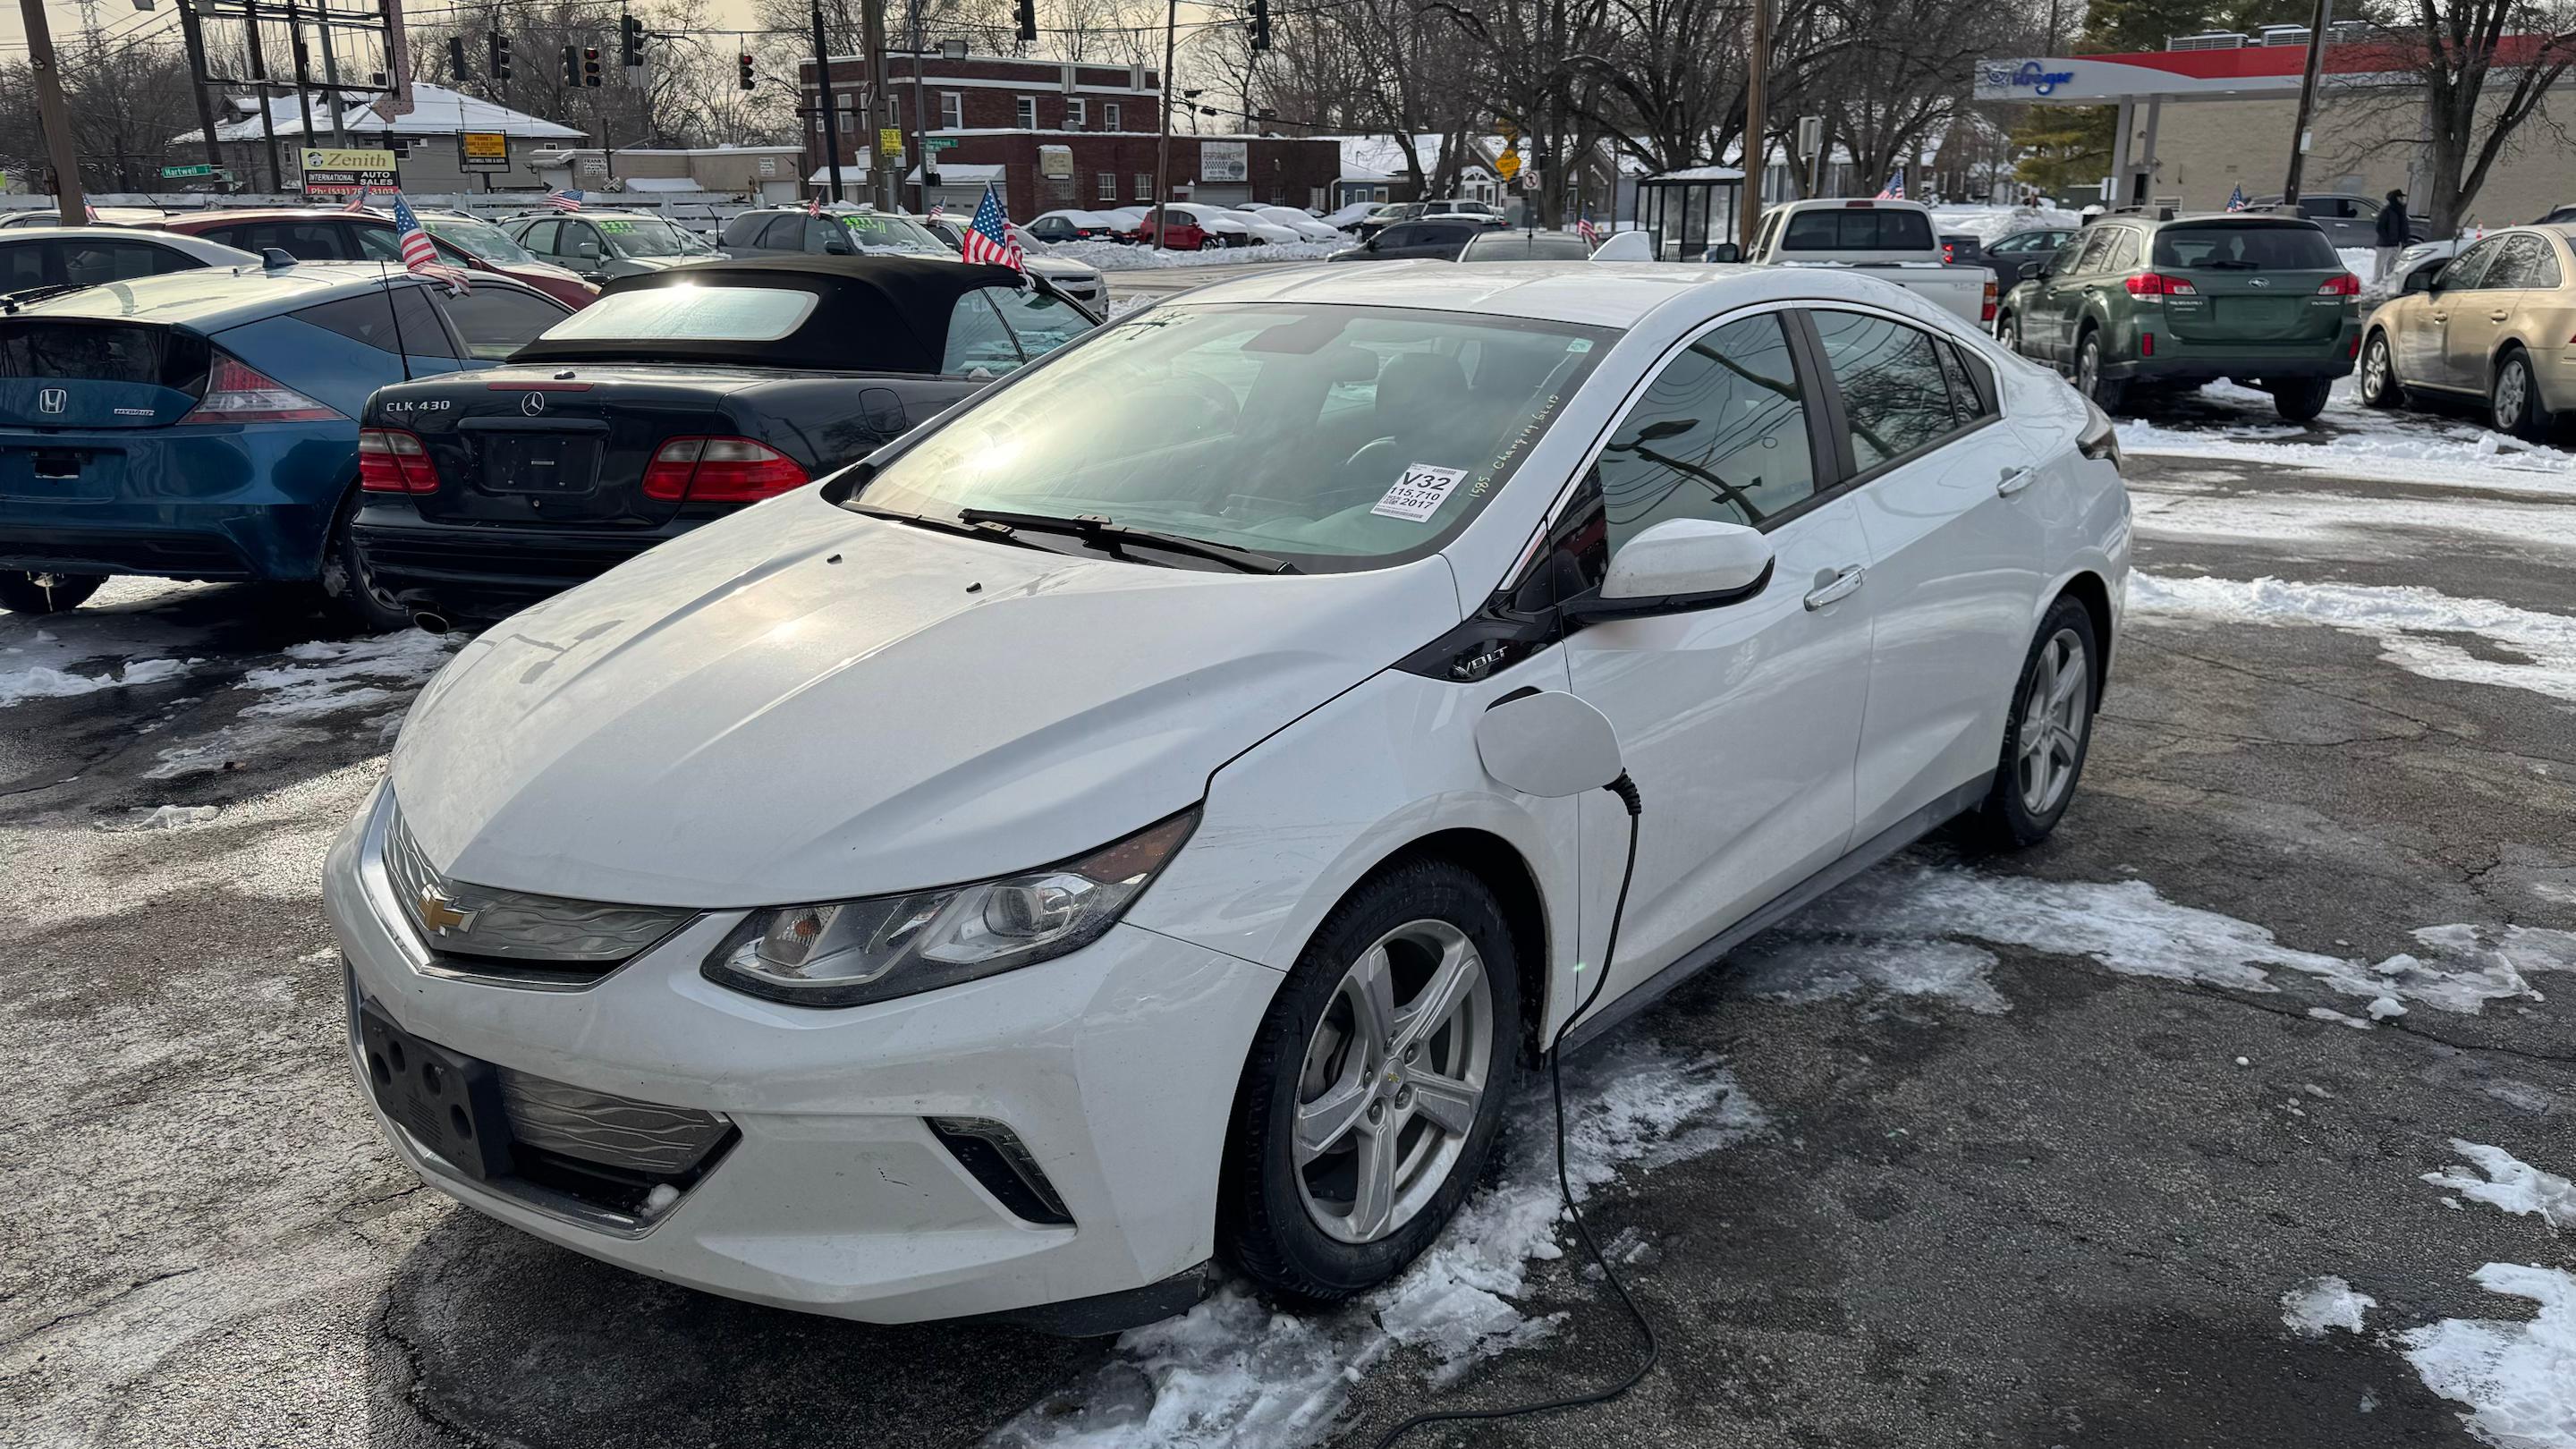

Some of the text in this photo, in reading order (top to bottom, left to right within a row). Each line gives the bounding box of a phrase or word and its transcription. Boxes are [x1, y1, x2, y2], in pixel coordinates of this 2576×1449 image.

[327, 152, 387, 167] Zenith
[165, 166, 198, 177] Hartwell
[308, 173, 356, 182] INTERNATIONAL
[360, 171, 391, 179] AUTO
[360, 178, 394, 186] SALES
[386, 400, 451, 412] CLK 430
[1402, 471, 1452, 491] V32
[1389, 487, 1441, 501] 115,710
[1399, 497, 1435, 509] 2017
[1452, 645, 1509, 676] VOLT
